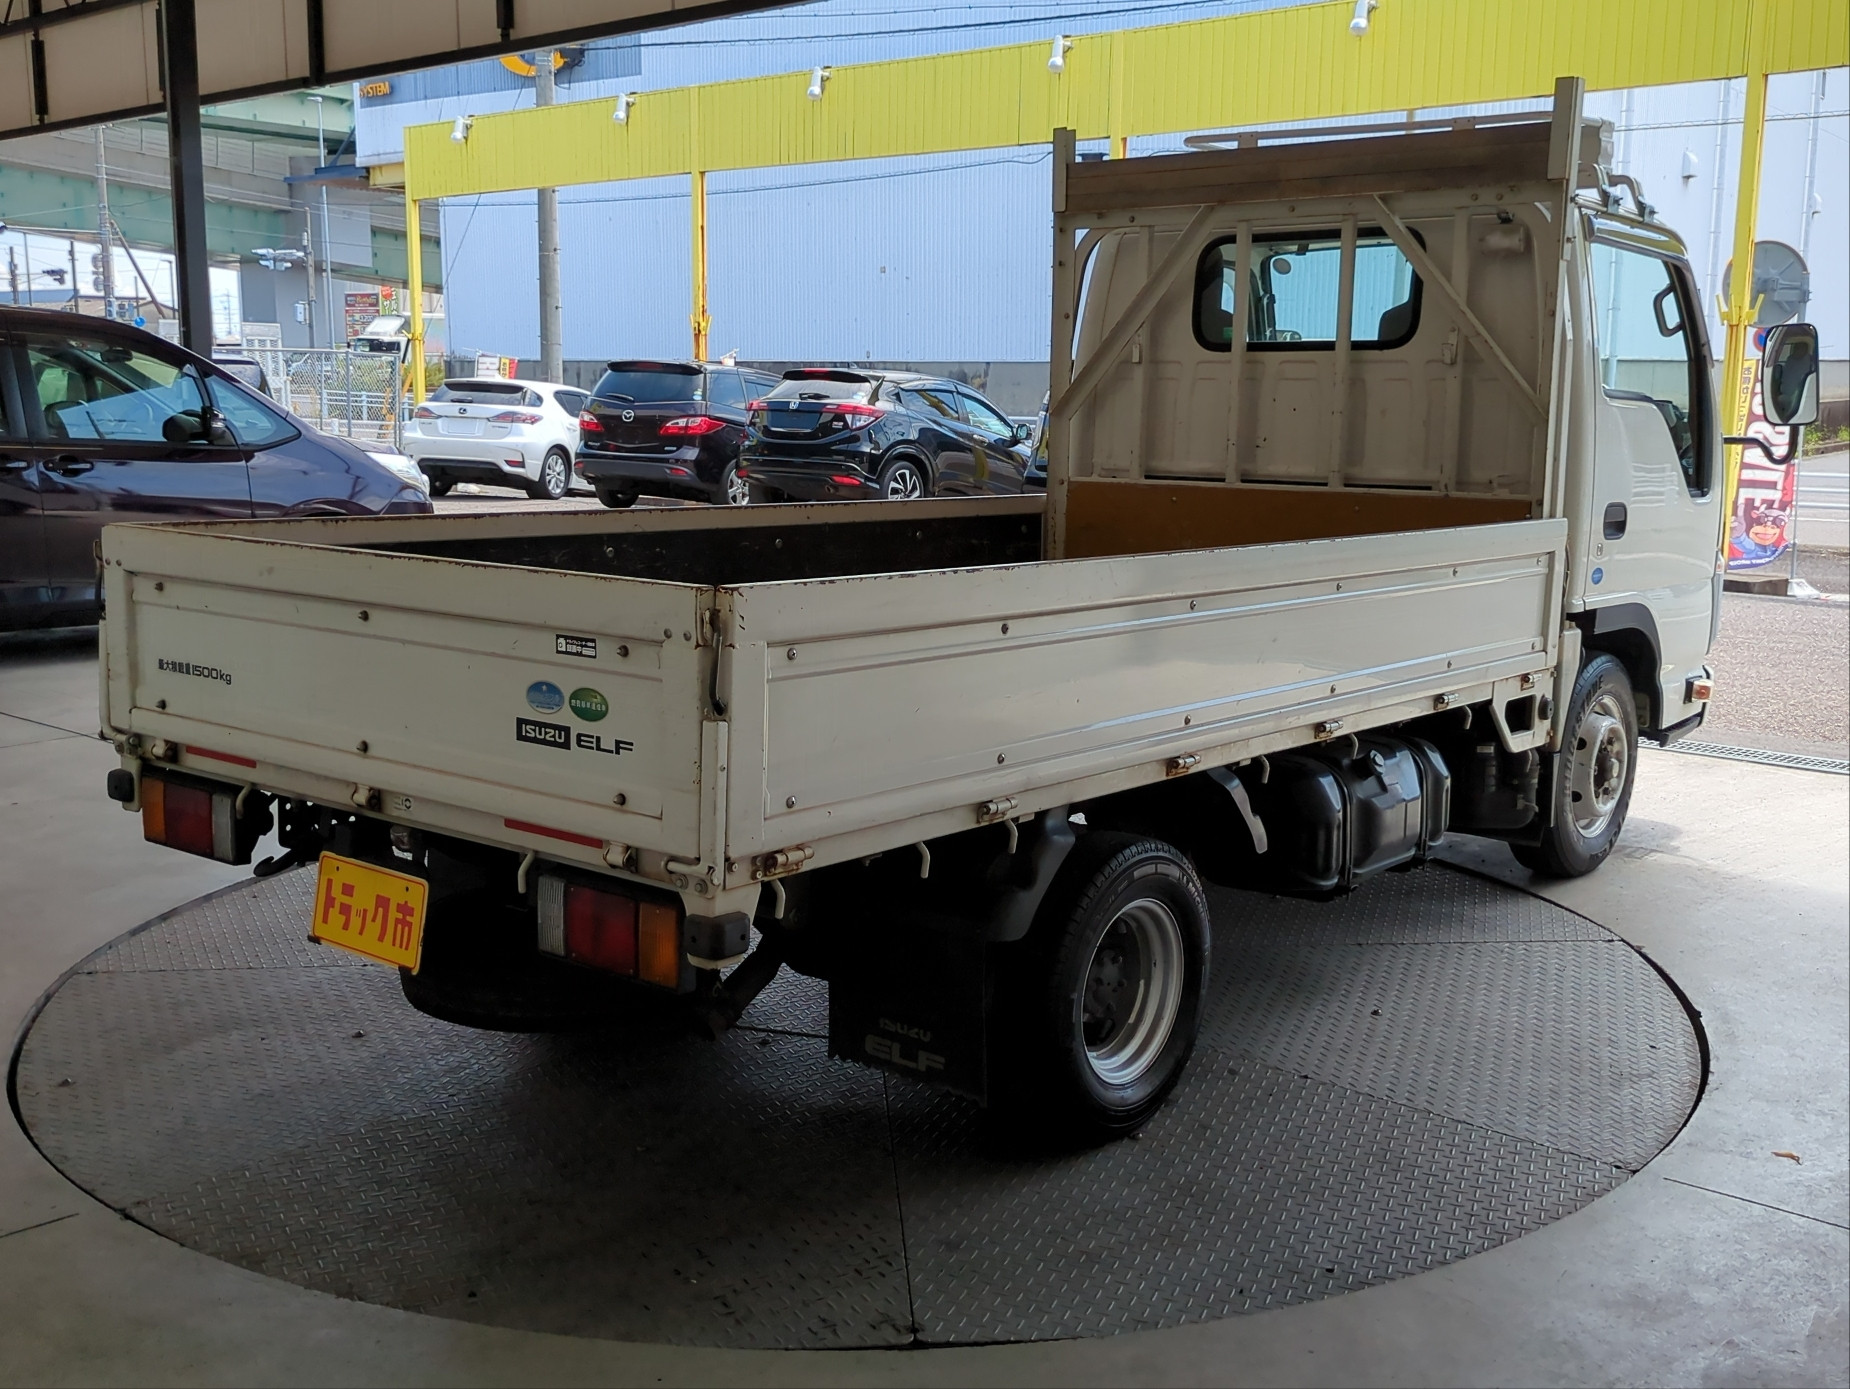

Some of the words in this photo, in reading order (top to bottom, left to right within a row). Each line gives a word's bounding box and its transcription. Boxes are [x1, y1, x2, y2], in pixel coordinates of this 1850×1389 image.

[359, 81, 390, 98] SYSTEM
[521, 723, 565, 743] ISUZU
[575, 732, 635, 756] ELF
[321, 878, 415, 951] トラック市
[864, 1034, 946, 1072] ELF
